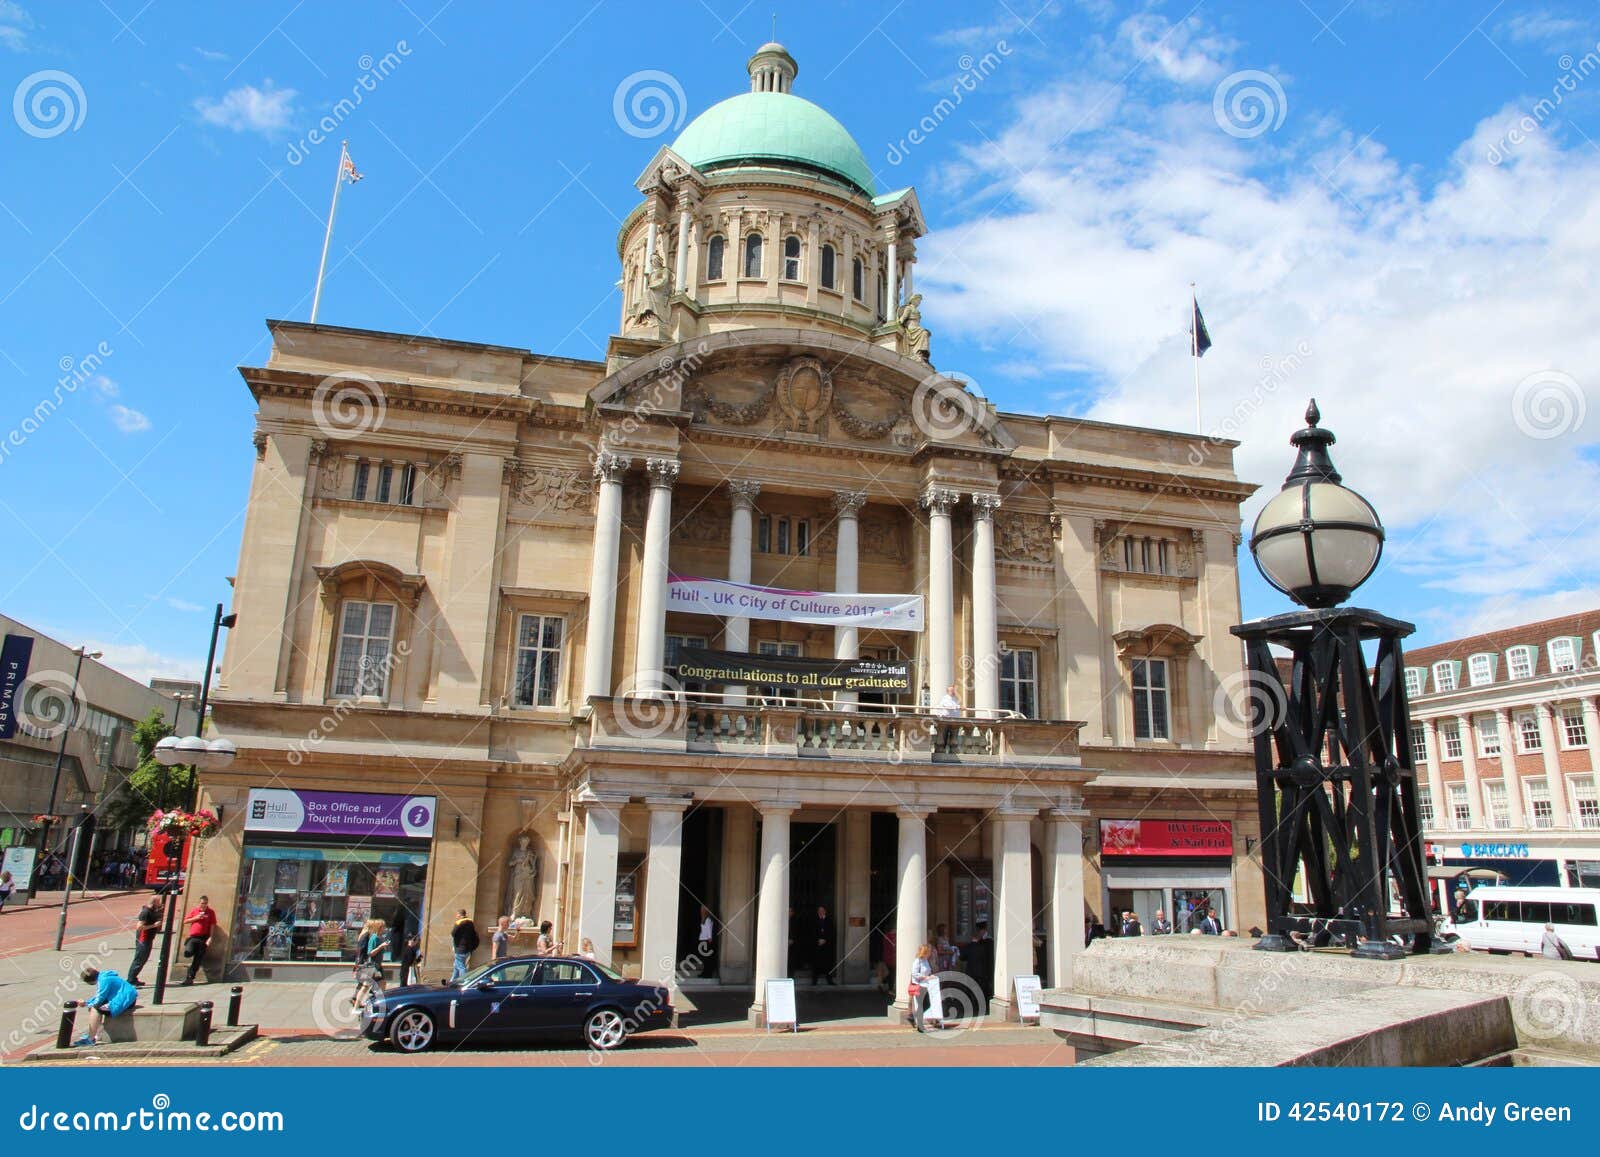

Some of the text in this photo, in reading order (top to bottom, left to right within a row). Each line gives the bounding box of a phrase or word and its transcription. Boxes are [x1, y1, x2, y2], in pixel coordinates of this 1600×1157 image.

[671, 588, 699, 601] Hull
[714, 592, 735, 605] UK
[739, 595, 767, 610] City
[772, 598, 786, 610] of
[790, 600, 840, 614] Culture
[845, 605, 876, 616] 2017
[679, 664, 907, 689] Congratulations to all our graduates
[888, 666, 906, 674] Hull
[267, 803, 287, 812] Hull
[309, 802, 381, 813] Box Office and
[308, 813, 340, 823] Tourist
[344, 815, 399, 826] Information
[1474, 843, 1529, 857] BARCLAYS
